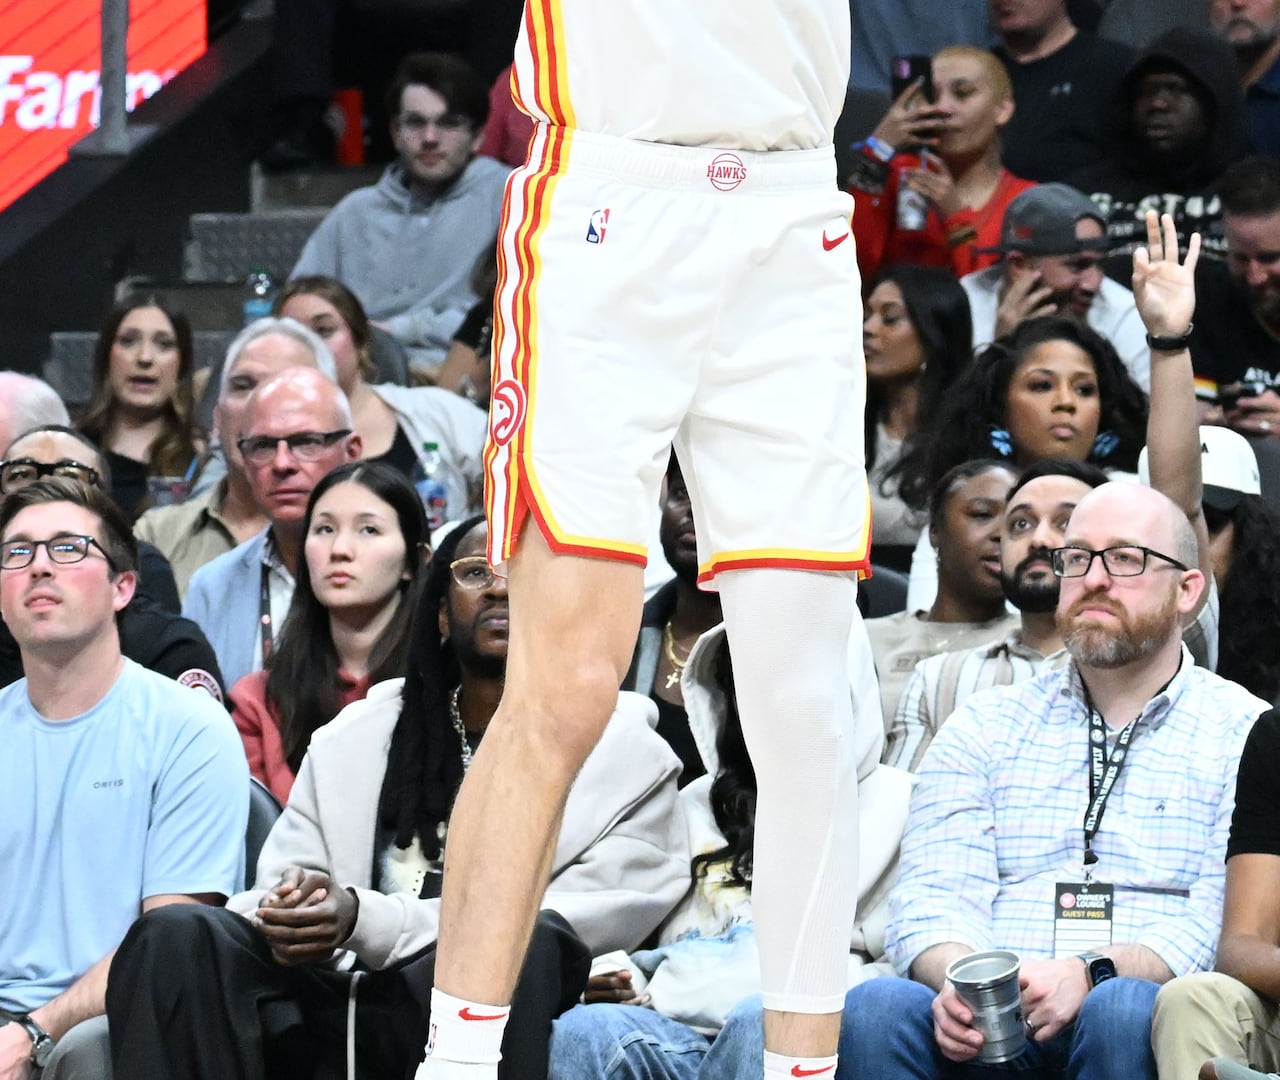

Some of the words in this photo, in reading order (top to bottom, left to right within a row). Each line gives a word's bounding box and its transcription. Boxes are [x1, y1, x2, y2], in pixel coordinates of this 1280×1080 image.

[706, 165, 747, 180] HAWKS
[1085, 796, 1105, 831] ATLANTA
[1099, 765, 1118, 796] HAWKS
[1062, 910, 1085, 918] GUEST
